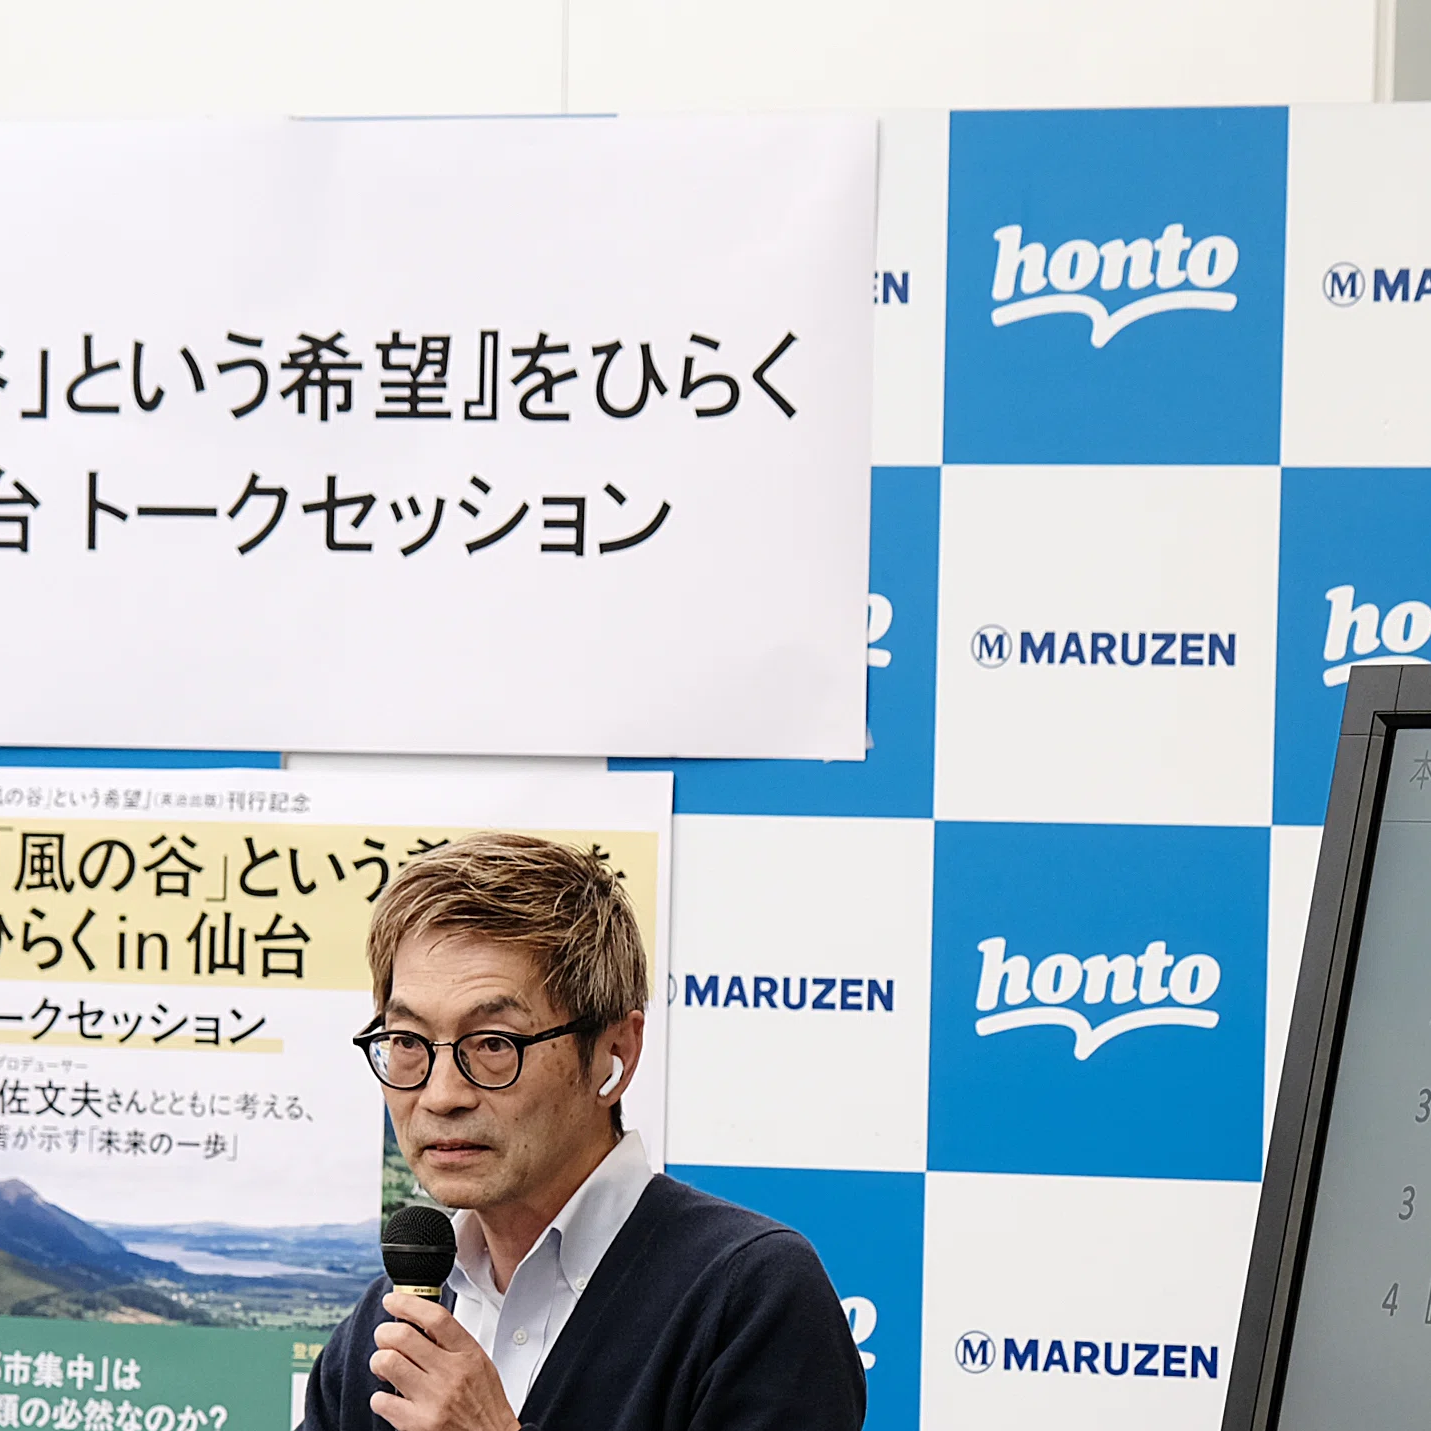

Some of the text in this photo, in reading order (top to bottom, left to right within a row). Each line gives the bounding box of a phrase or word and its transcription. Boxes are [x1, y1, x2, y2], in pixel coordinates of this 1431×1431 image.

[991, 223, 1239, 300] honto
[87, 471, 672, 557] トークセッション
[1019, 631, 1237, 668] MARUZEN
[684, 974, 895, 1012] MARUZEN
[975, 936, 1221, 1011] honto
[1003, 1336, 1219, 1380] MARUZEN
